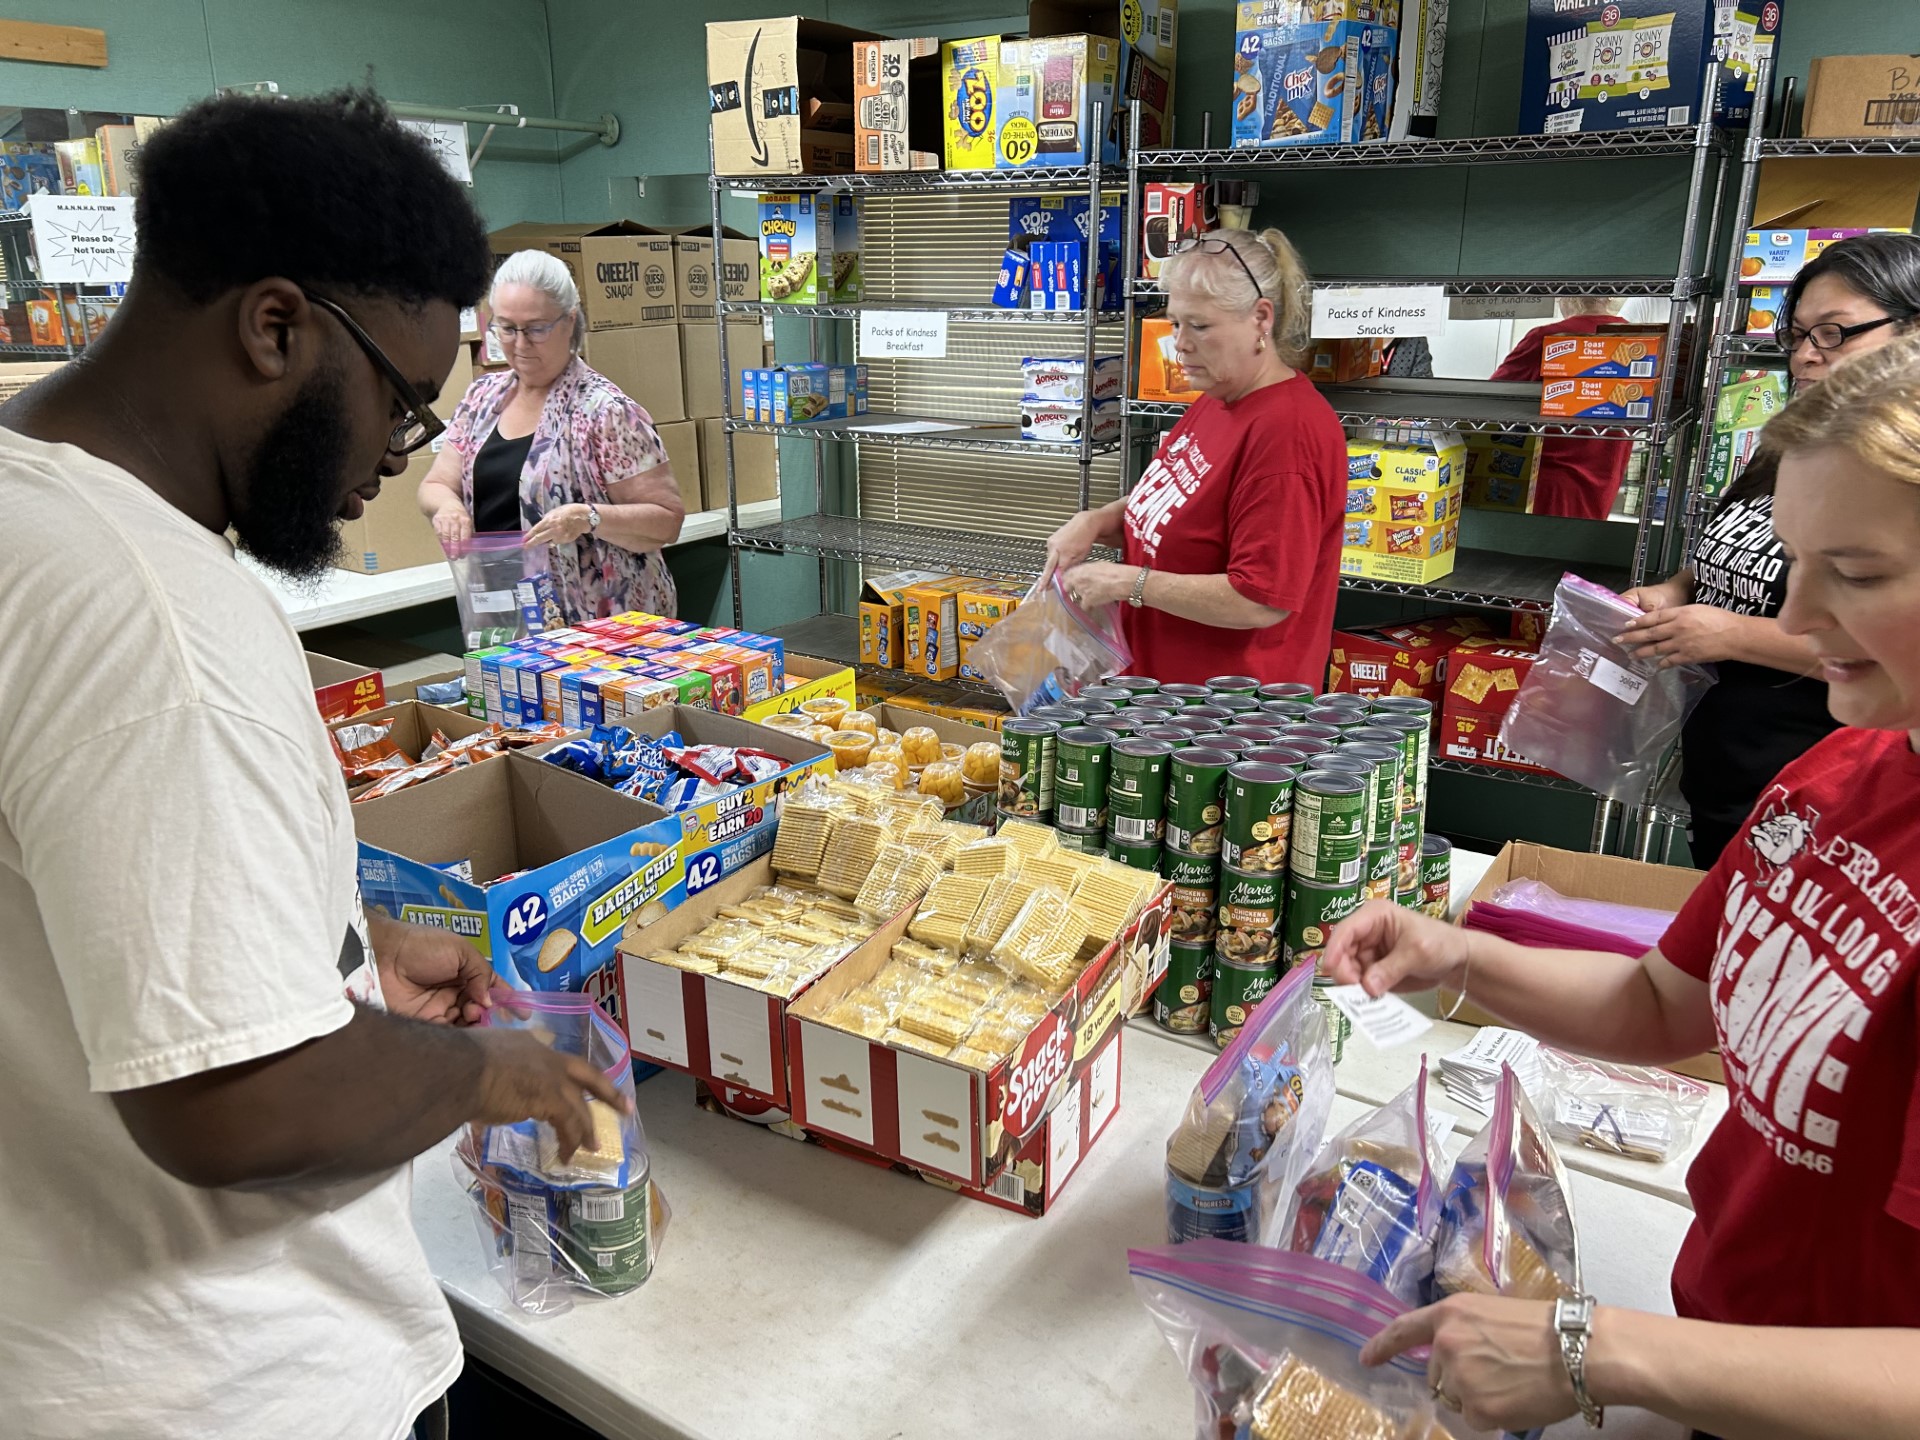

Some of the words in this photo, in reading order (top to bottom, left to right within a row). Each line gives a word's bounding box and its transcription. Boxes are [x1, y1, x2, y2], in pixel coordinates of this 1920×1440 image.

[1604, 10, 1617, 20] 36
[1765, 8, 1776, 21] 36
[1241, 35, 1260, 54] 42
[1362, 30, 1371, 47] 42
[1595, 35, 1624, 48] SKINNY
[1634, 29, 1663, 43] SKINNY
[1593, 47, 1622, 64] POP
[1633, 41, 1662, 59] POP
[888, 54, 900, 78] 30
[1632, 57, 1661, 65] POPCORN
[1265, 53, 1287, 116] TRADITIONAL
[1284, 66, 1314, 88] Chex
[1287, 84, 1312, 101] mix
[1363, 57, 1376, 117] TRADITIONAL
[965, 71, 991, 132] ZOO
[1006, 140, 1031, 160] 60
[597, 261, 639, 283] CHEEZ-IT
[645, 274, 664, 285] QUESO
[1461, 296, 1484, 304] Packs
[1501, 296, 1542, 304] Kindness
[1328, 308, 1358, 319] Packs
[1361, 306, 1373, 319] of
[1378, 306, 1426, 319] Kindness
[1484, 309, 1516, 318] Snacks
[871, 327, 893, 336] Packs
[895, 327, 904, 336] of
[906, 328, 937, 337] Kindness
[1357, 324, 1395, 336] Snacks
[886, 341, 924, 351] Breakfast
[1547, 343, 1575, 357] Lance
[1546, 383, 1573, 395] Lance
[1395, 467, 1427, 476] CLASSIC
[1392, 529, 1410, 539] Nutter
[1696, 538, 1716, 560] GO
[1710, 542, 1734, 566] ON
[1726, 550, 1783, 582] AHEAD
[1700, 563, 1731, 593] DECIDE
[1733, 574, 1765, 603] HOW
[1395, 651, 1409, 664] 45
[1351, 663, 1388, 681] CHEEZ-IT
[354, 678, 376, 696] 45
[353, 694, 380, 706] Pouches
[1457, 722, 1476, 733] 45
[717, 791, 744, 815] BUY
[744, 788, 754, 804] 2
[708, 814, 746, 842] EARN
[745, 807, 763, 827] 20
[687, 857, 718, 892] 42
[721, 842, 739, 857] SINGLE
[740, 834, 756, 848] SERVE
[723, 843, 756, 870] BAGS!
[363, 867, 388, 882] BAGS!
[1171, 862, 1212, 875] Marie
[548, 881, 569, 896] SINGLE
[569, 866, 588, 884] SERVE
[1170, 873, 1215, 884] Callender's
[552, 874, 590, 909] BAGS!
[593, 877, 643, 927] BAGEL
[643, 849, 678, 887] CHIP
[1175, 888, 1201, 897] CHICKEN
[1230, 881, 1273, 895] Marie
[621, 905, 630, 920] IS
[630, 884, 658, 912] BACK!
[1161, 892, 1172, 908] 36
[1172, 892, 1208, 902] DUMPLINGS
[1229, 893, 1276, 904] Callender's
[507, 897, 546, 939] 42
[1231, 914, 1269, 923] DUMPLINGS
[1234, 908, 1261, 917] CHICKEN
[408, 911, 448, 928] BAGEL
[452, 915, 482, 935] CHIP
[1082, 997, 1093, 1020] 18
[1083, 1023, 1093, 1045] 18
[1094, 998, 1115, 1030] Vanilla
[1008, 1015, 1068, 1117] Snack
[1020, 1047, 1067, 1127] pack
[1774, 1136, 1833, 1175] 1946
